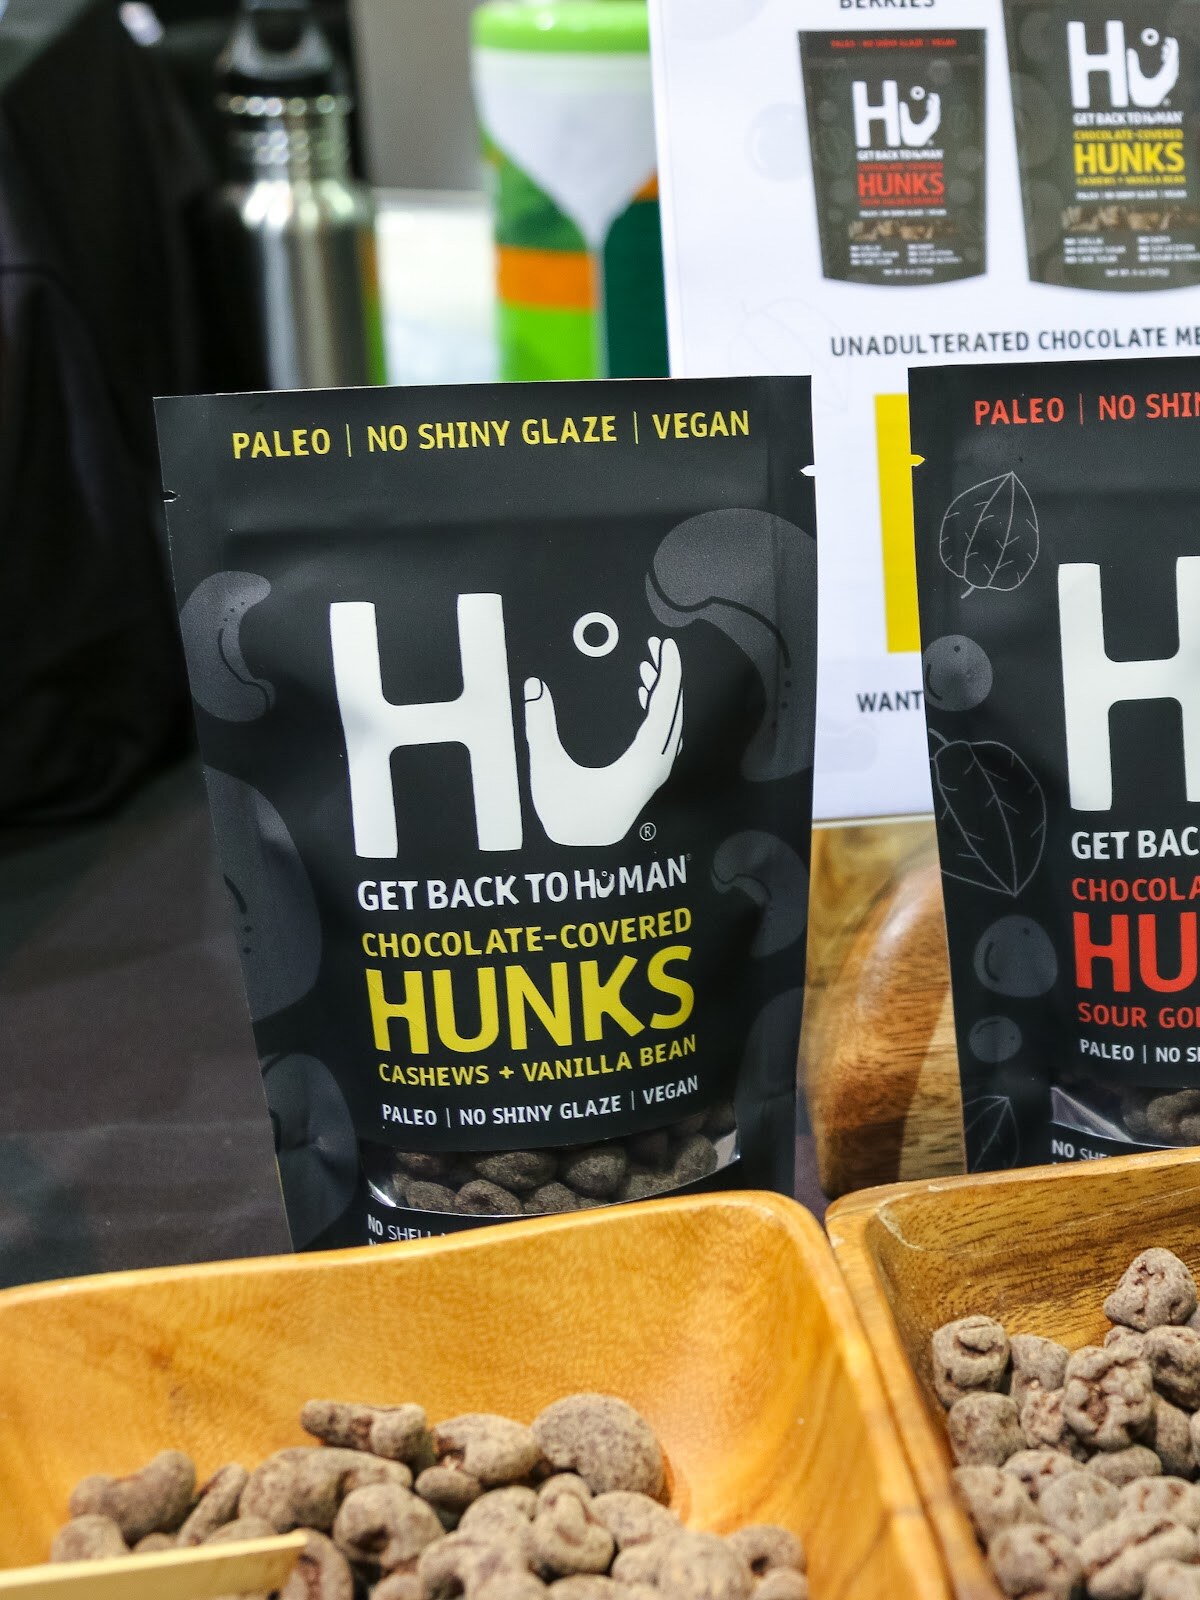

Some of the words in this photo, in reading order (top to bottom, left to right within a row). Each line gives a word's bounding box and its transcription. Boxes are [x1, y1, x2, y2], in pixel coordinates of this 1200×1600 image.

[1073, 112, 1094, 126] GET
[1096, 112, 1126, 126] BACK
[1074, 141, 1185, 174] HUNKS
[858, 172, 945, 197] HUNKS
[831, 331, 1029, 356] UNADULTERATED
[1038, 327, 1167, 350] CHOCOLATE
[975, 398, 1064, 425] PALEO
[1099, 395, 1135, 420] NO
[233, 429, 330, 459] PALEO
[368, 425, 407, 452] NO
[418, 420, 510, 449] SHINY
[522, 416, 616, 444] GLAZE
[652, 410, 749, 439] VEGAN
[1071, 831, 1130, 859] GET
[358, 881, 418, 910] GET
[427, 875, 519, 909] BACK
[525, 872, 568, 903] TO
[362, 907, 691, 958] CHOCOLATE-COVERED
[365, 945, 694, 1054] HUNKS
[1078, 1002, 1147, 1028] SOUR
[379, 1064, 489, 1086] CASHEWS
[522, 1052, 632, 1081] VANILLA
[640, 1034, 695, 1066] BEAN
[1080, 1039, 1134, 1061] PALEO
[1156, 1047, 1180, 1062] NO
[382, 1104, 437, 1125] PALEO
[460, 1109, 486, 1125] NO
[492, 1105, 552, 1124] SHINY
[560, 1095, 621, 1119] GLAZE
[643, 1075, 697, 1104] VEGAN
[1051, 1139, 1075, 1158] NO
[367, 1213, 384, 1236] NO
